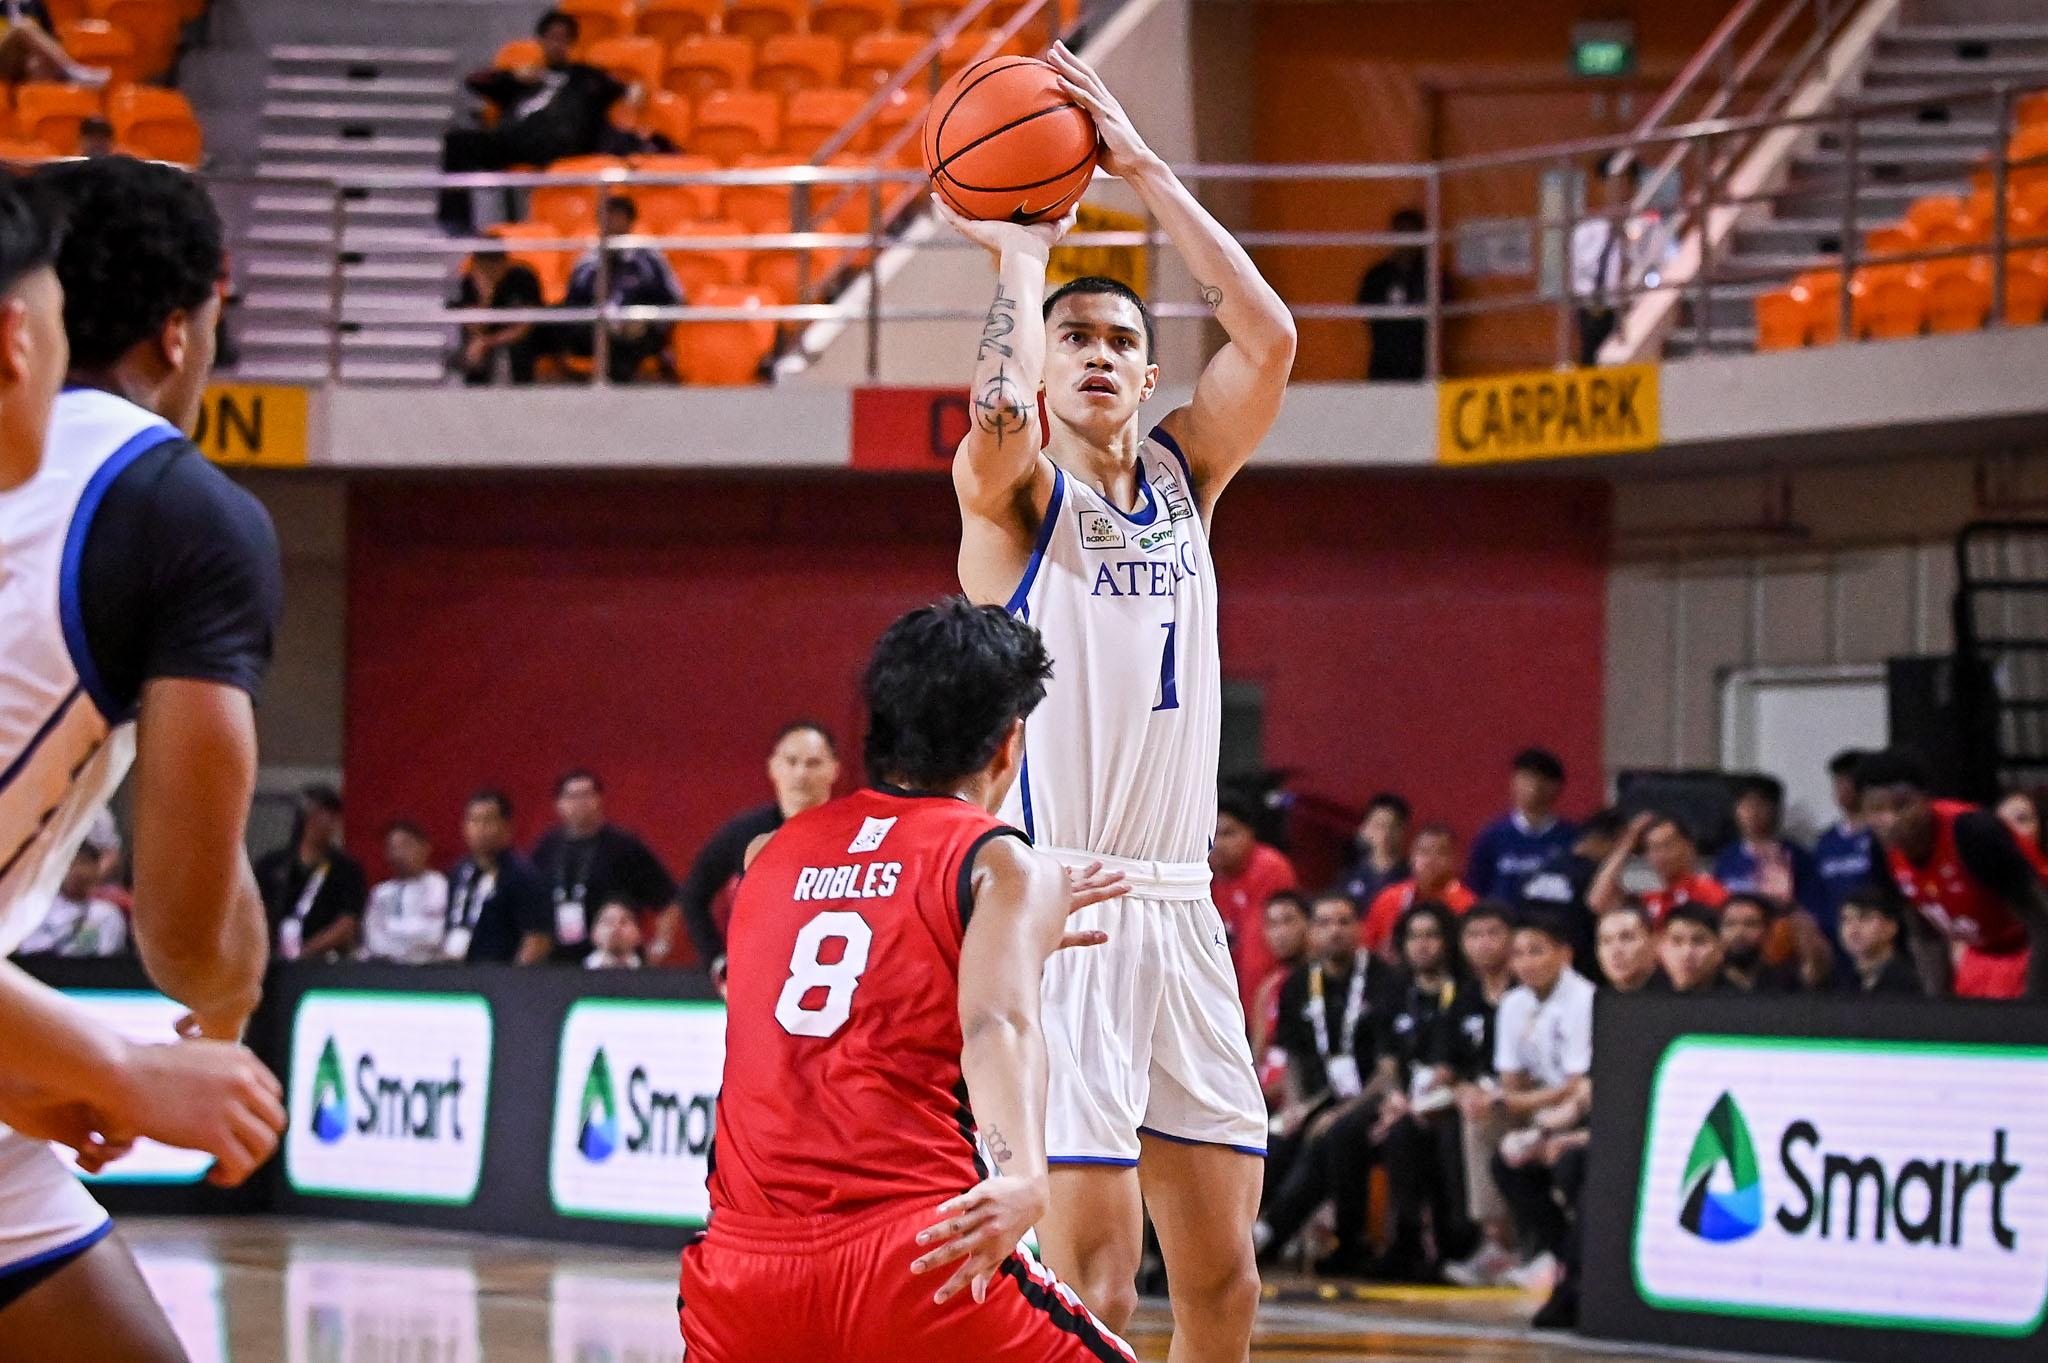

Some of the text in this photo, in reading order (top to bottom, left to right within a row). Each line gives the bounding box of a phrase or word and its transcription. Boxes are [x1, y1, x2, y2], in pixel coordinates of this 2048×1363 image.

[1452, 375, 1641, 450] CARPARK
[1090, 540, 1197, 597] ATENO
[1151, 527, 1175, 543] Sma
[1152, 621, 1181, 712] 1
[793, 861, 903, 901] ROBLES
[774, 911, 873, 1038] 8
[356, 1052, 465, 1142] Smart
[625, 1064, 717, 1157] Sma
[1775, 1119, 2021, 1252] Smart
